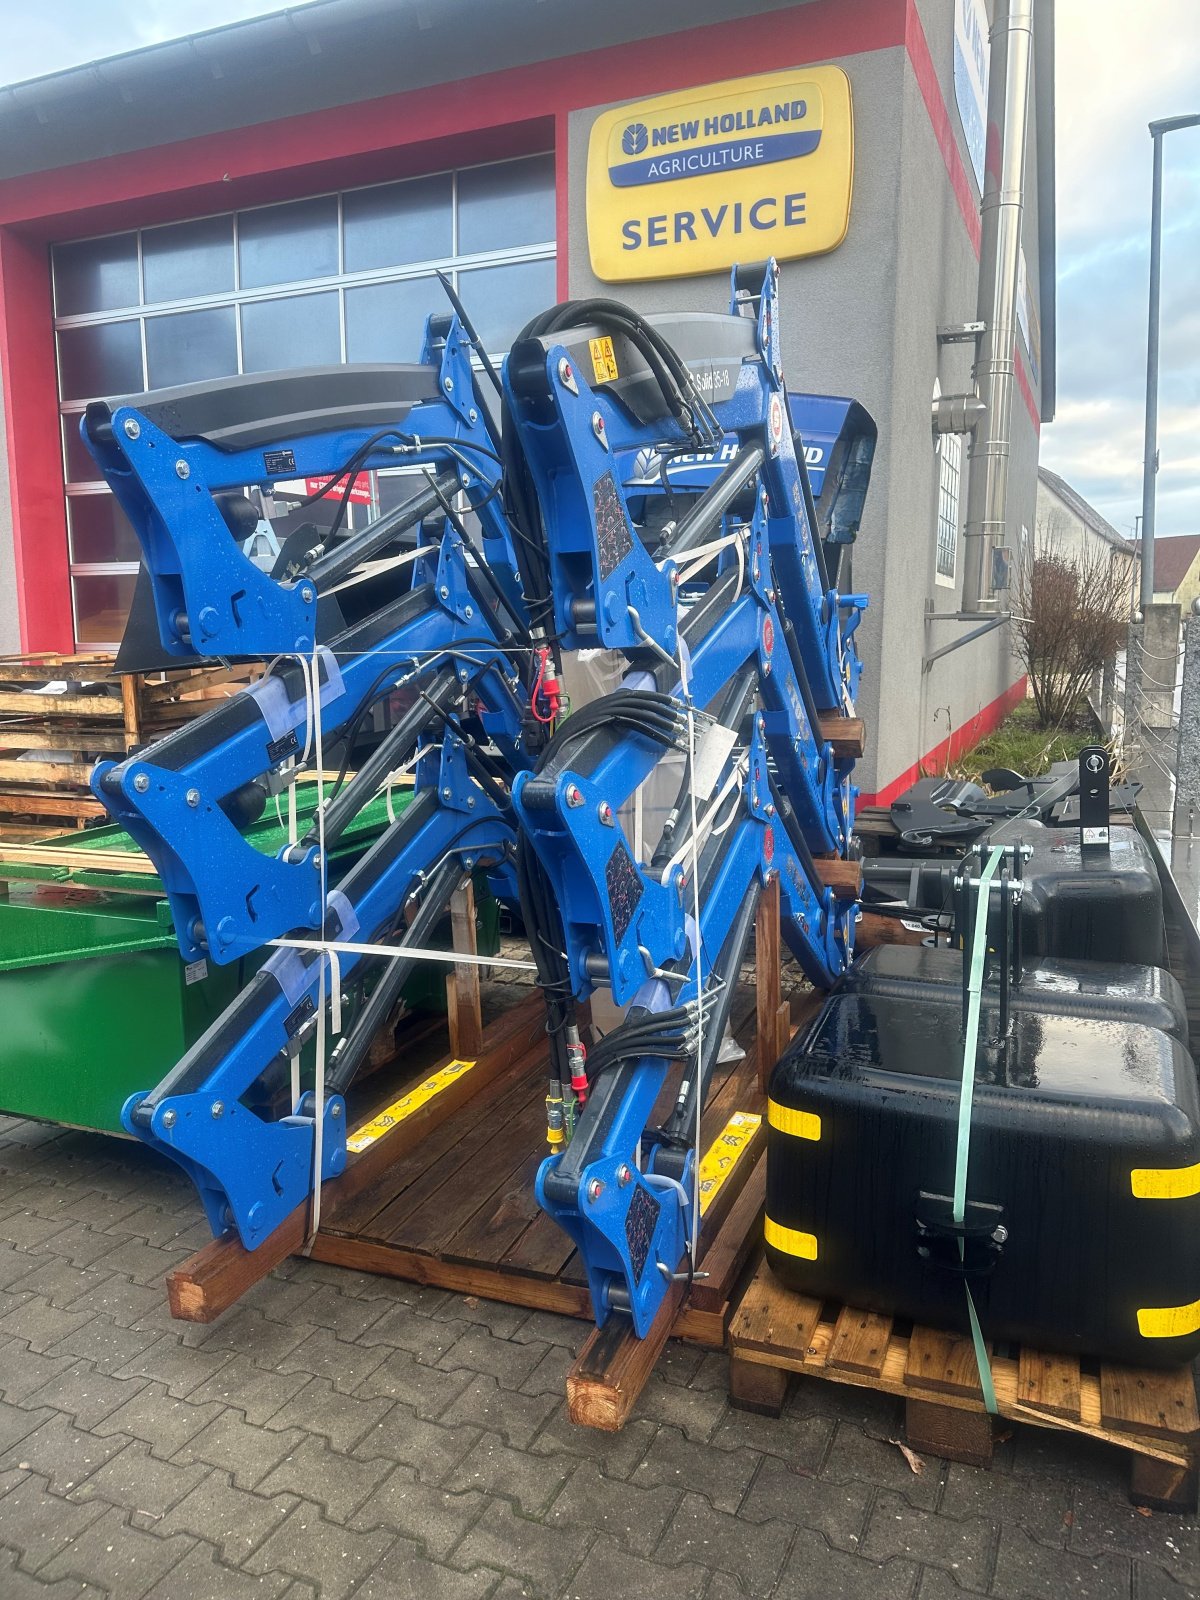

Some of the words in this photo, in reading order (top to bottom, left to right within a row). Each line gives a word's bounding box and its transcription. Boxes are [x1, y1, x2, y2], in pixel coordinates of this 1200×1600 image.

[652, 119, 699, 147] NEW
[704, 99, 807, 137] HOLLAND
[647, 143, 764, 178] AGRICULTURE
[621, 192, 807, 251] SERVICE
[696, 372, 713, 391] Solid
